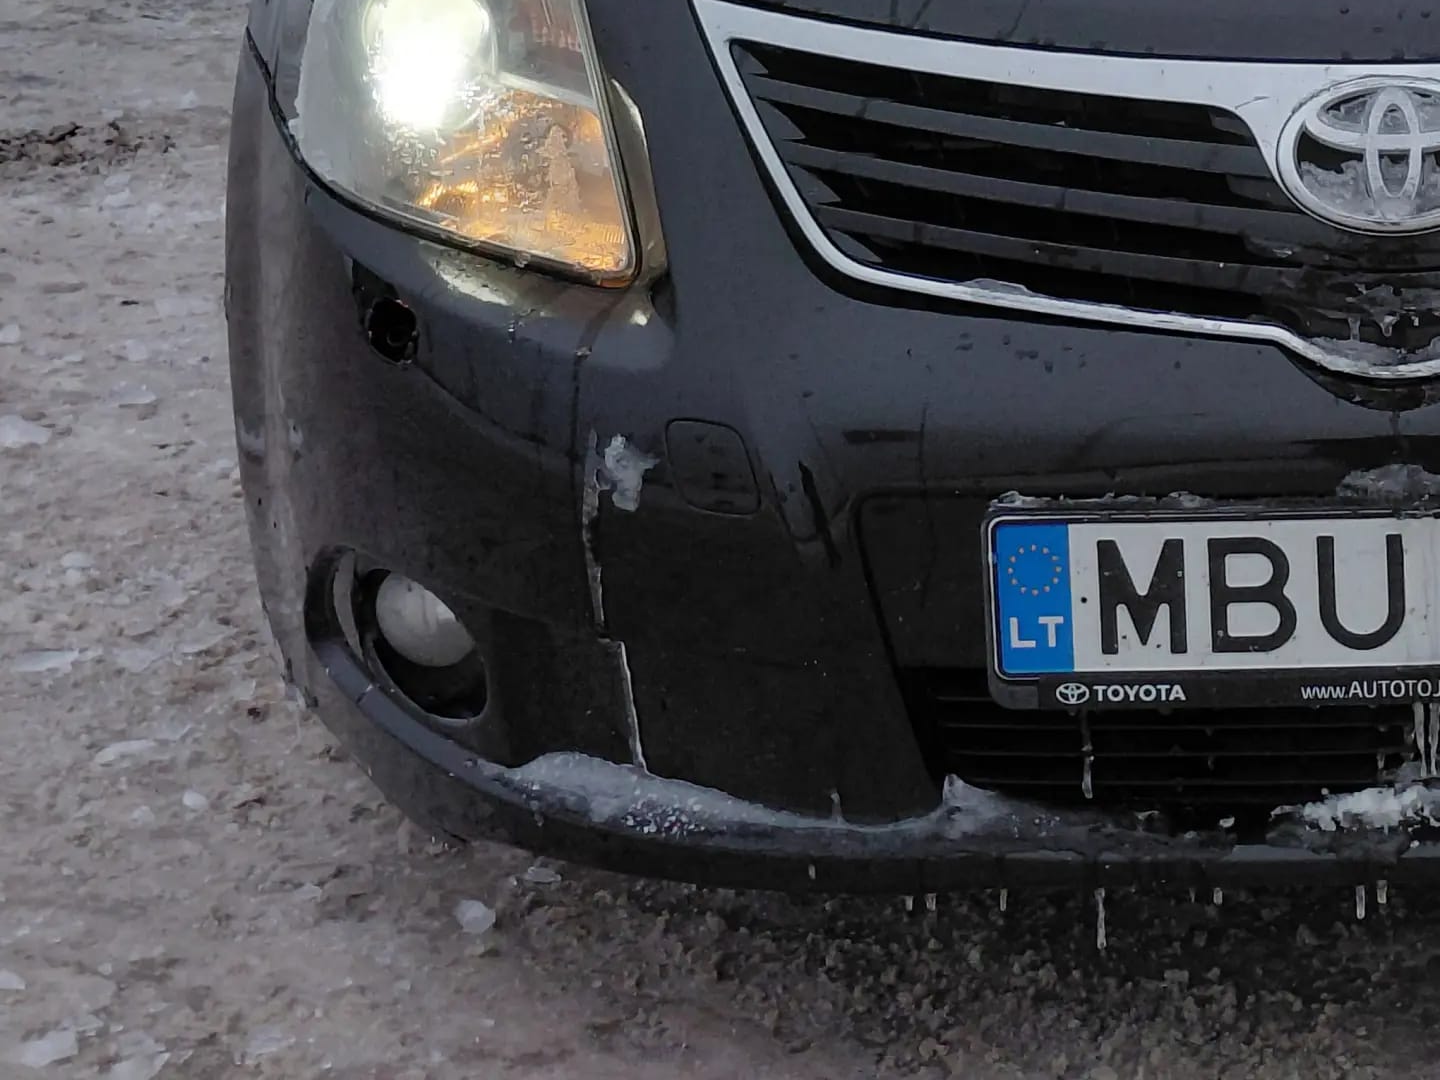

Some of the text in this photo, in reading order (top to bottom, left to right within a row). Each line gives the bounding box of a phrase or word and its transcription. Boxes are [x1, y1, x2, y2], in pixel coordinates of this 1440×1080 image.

[1096, 532, 1407, 655] MBU
[1008, 615, 1065, 649] LT
[1092, 683, 1188, 703] TOYOTA
